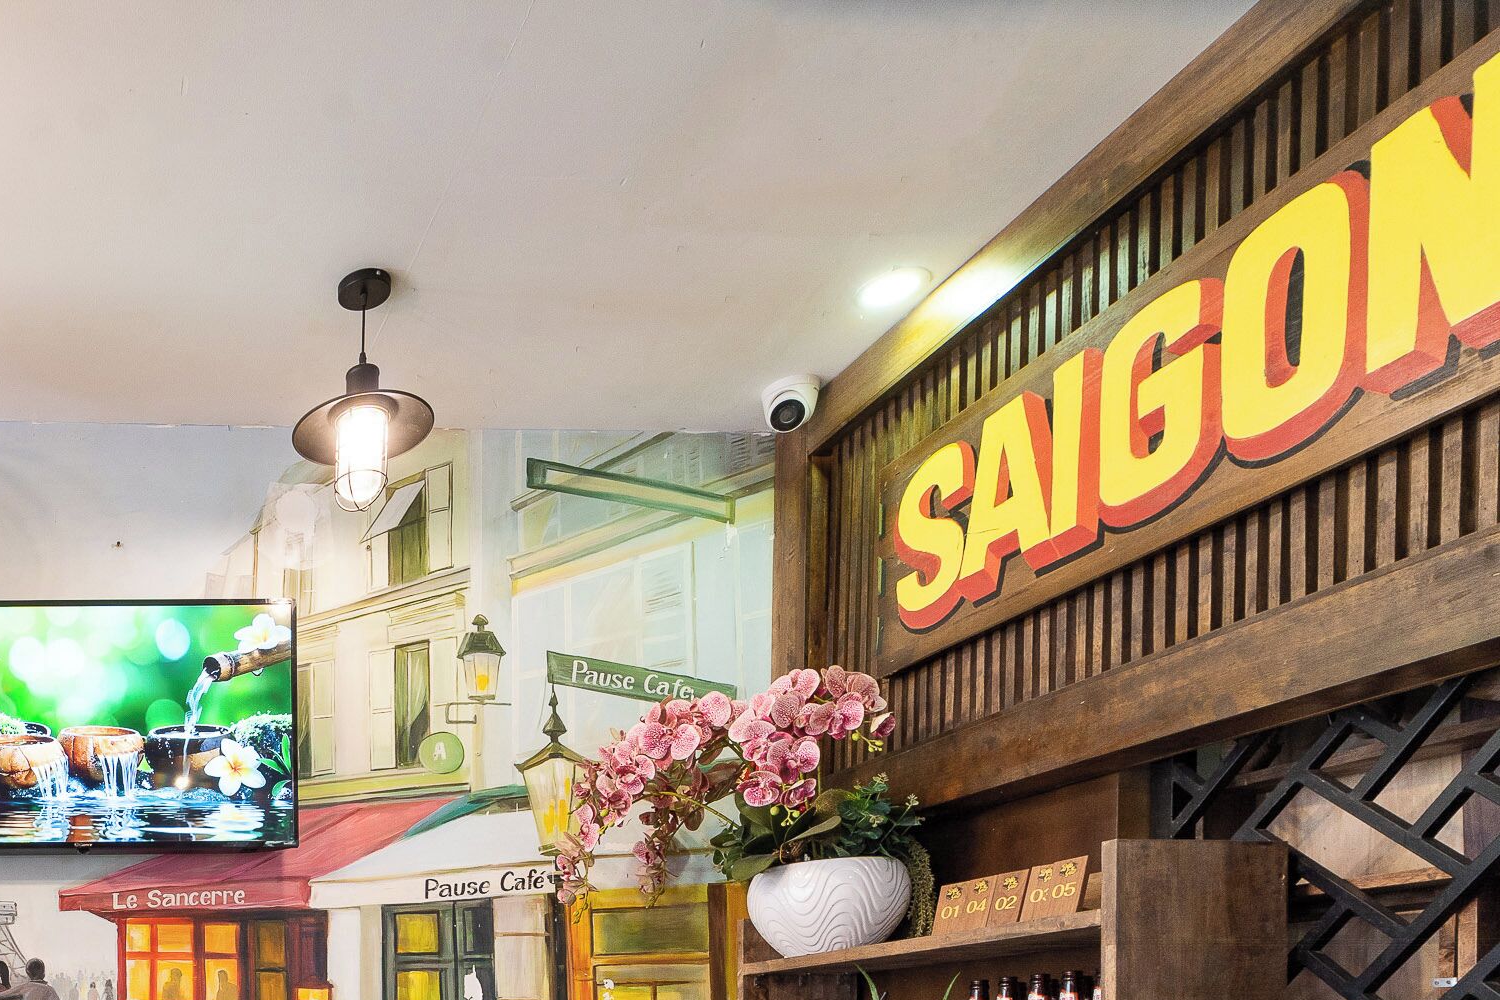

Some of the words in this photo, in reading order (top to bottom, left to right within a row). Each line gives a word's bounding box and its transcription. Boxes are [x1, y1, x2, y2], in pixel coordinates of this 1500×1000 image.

[894, 52, 1500, 634] SAIGON
[571, 659, 635, 690] Pause
[424, 877, 491, 899] Pause
[500, 869, 546, 892] Café
[1052, 882, 1077, 899] 05
[112, 891, 138, 910] Le
[146, 887, 246, 908] Sancerre
[966, 898, 987, 914] 04
[995, 895, 1017, 911] 02
[941, 905, 959, 919] 01
